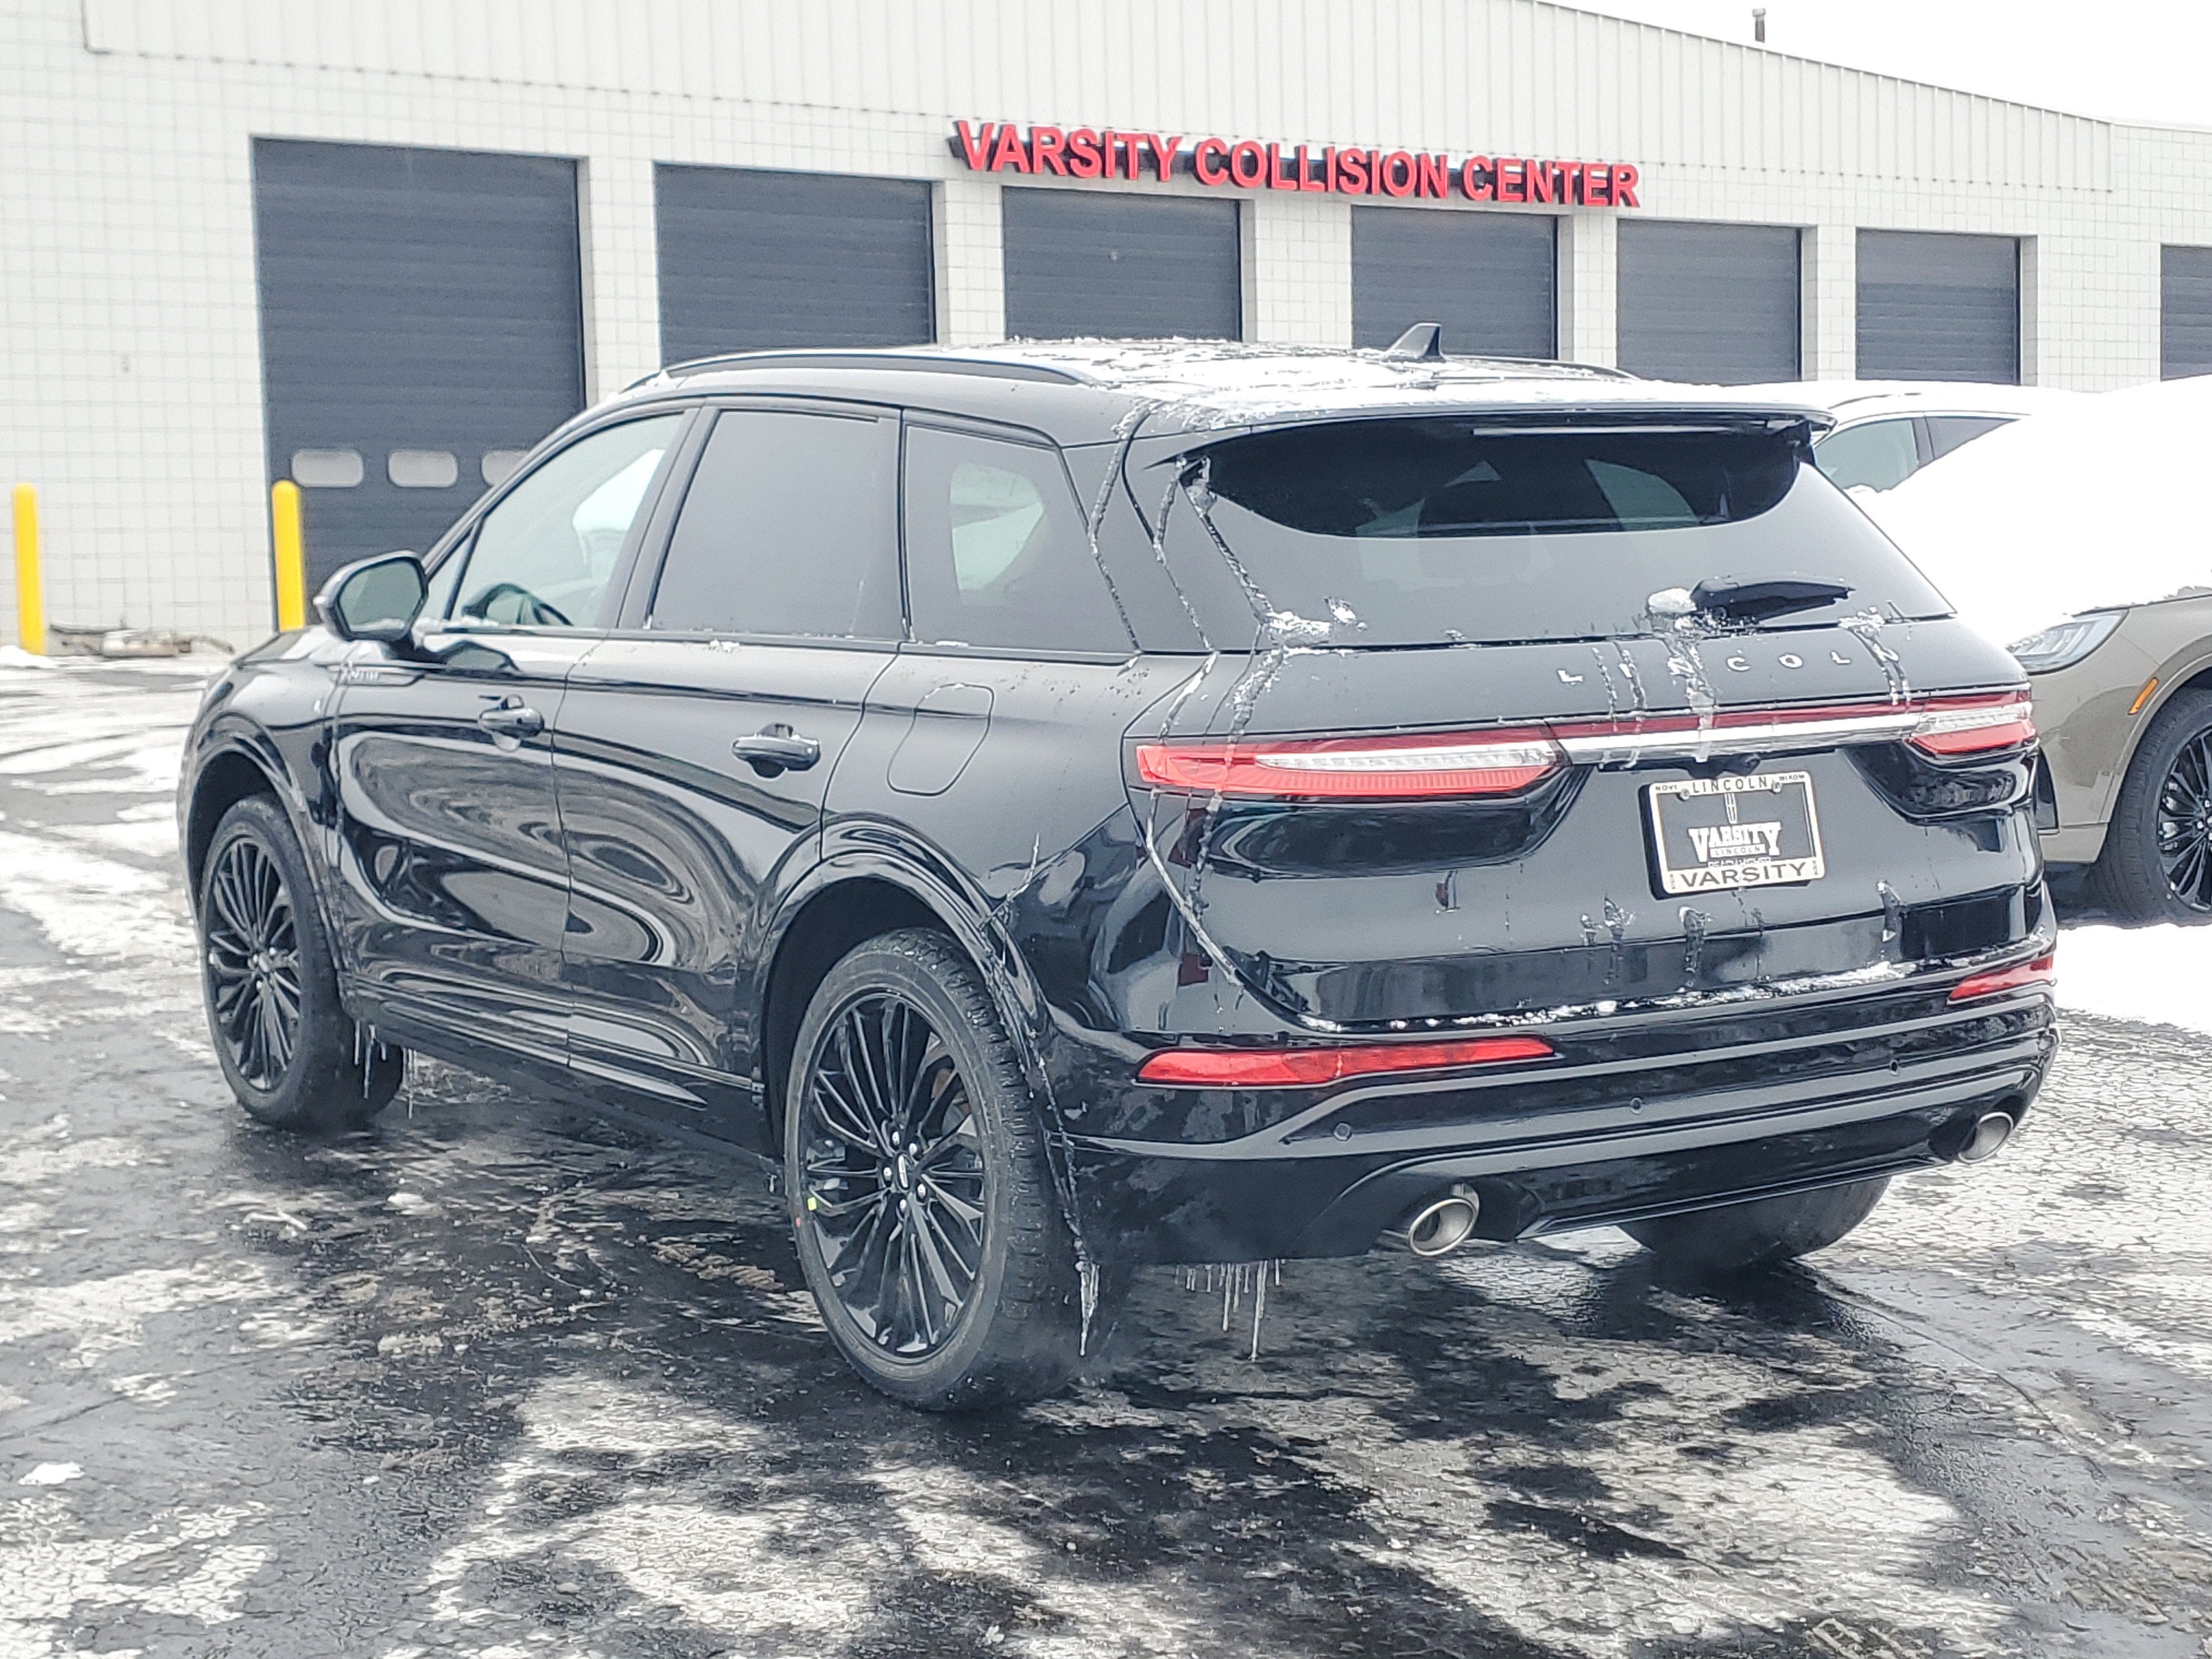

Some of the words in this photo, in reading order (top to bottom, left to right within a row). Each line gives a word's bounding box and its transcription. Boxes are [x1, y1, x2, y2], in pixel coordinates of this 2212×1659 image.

[958, 121, 1181, 182] VARSITY
[1195, 138, 1449, 199] COLLISION
[1463, 156, 1638, 207] CENTER
[1692, 776, 1768, 794] LINCOLN
[1688, 821, 1781, 862] VARSITY
[1715, 847, 1760, 856] LINCOLN
[1680, 861, 1806, 888] VARSITY
